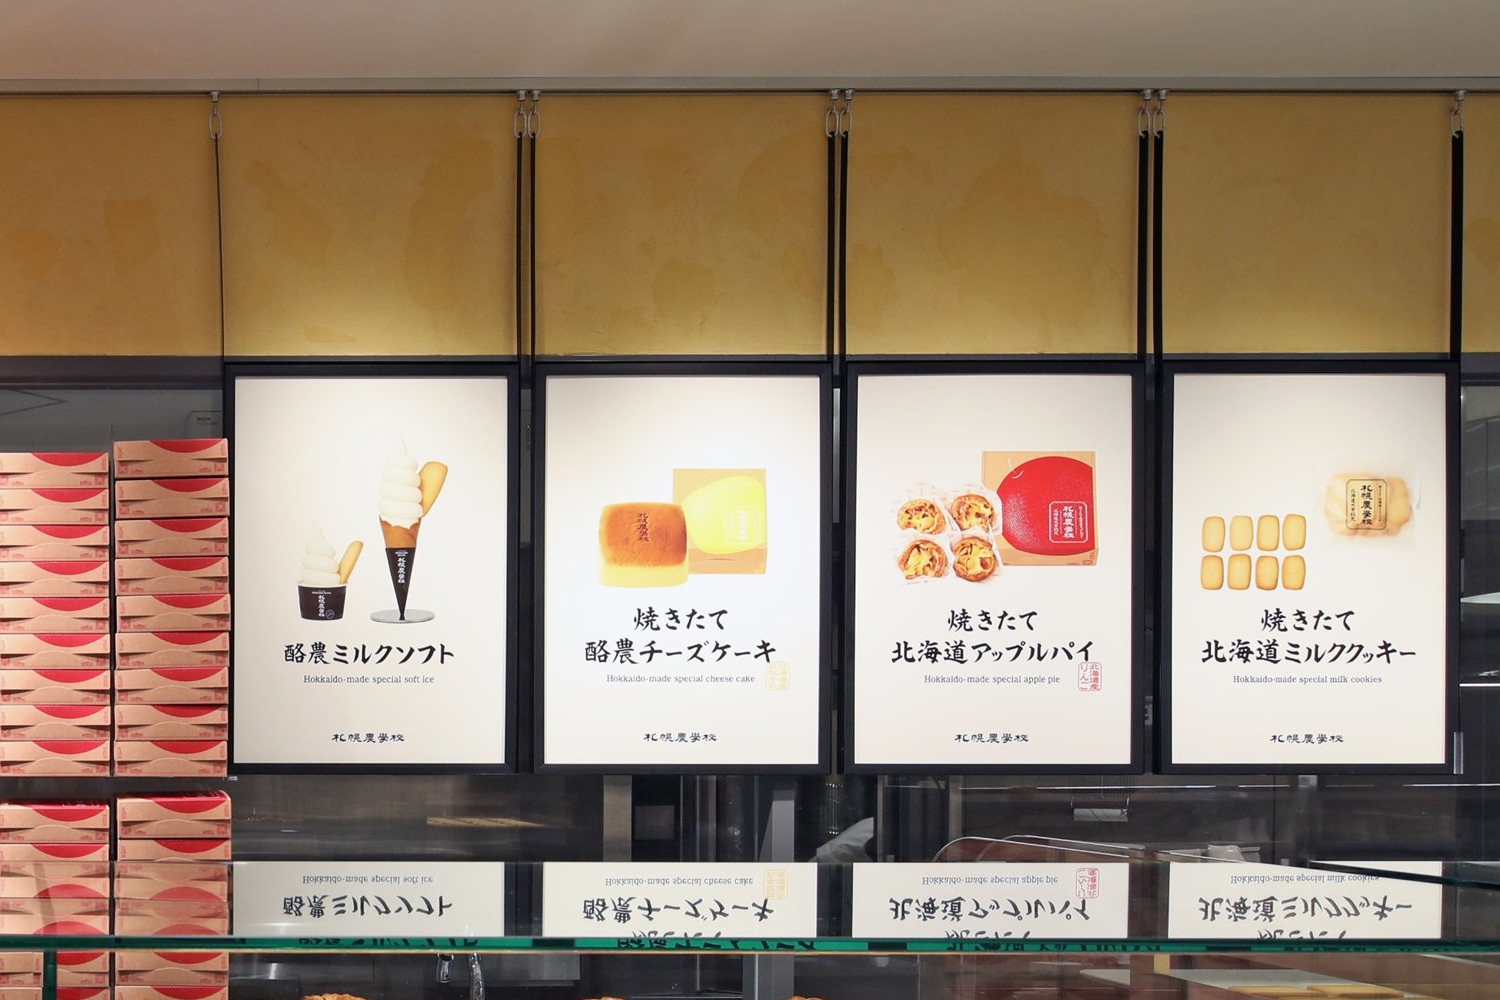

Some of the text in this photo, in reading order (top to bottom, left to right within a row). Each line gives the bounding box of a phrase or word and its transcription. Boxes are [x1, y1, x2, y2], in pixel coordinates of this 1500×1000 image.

[633, 606, 728, 632] 焼きたて
[947, 608, 1038, 632] 焼きたて
[1260, 607, 1355, 633] 焼きたて
[284, 641, 455, 665] 酪農ミルクソフト
[584, 637, 777, 665] 酪農チーズケーキ
[891, 639, 1093, 665] 北海道アップルパイ
[1201, 638, 1416, 665] 北海道ミルククッキー
[303, 674, 435, 685] Hokkaido-made special soft ice
[606, 674, 755, 684] Hokkaido-made special cheese cake
[923, 675, 1061, 685] Hokkaido-made special apple pie
[1233, 675, 1383, 685] Hokkaido-made special milk cookies
